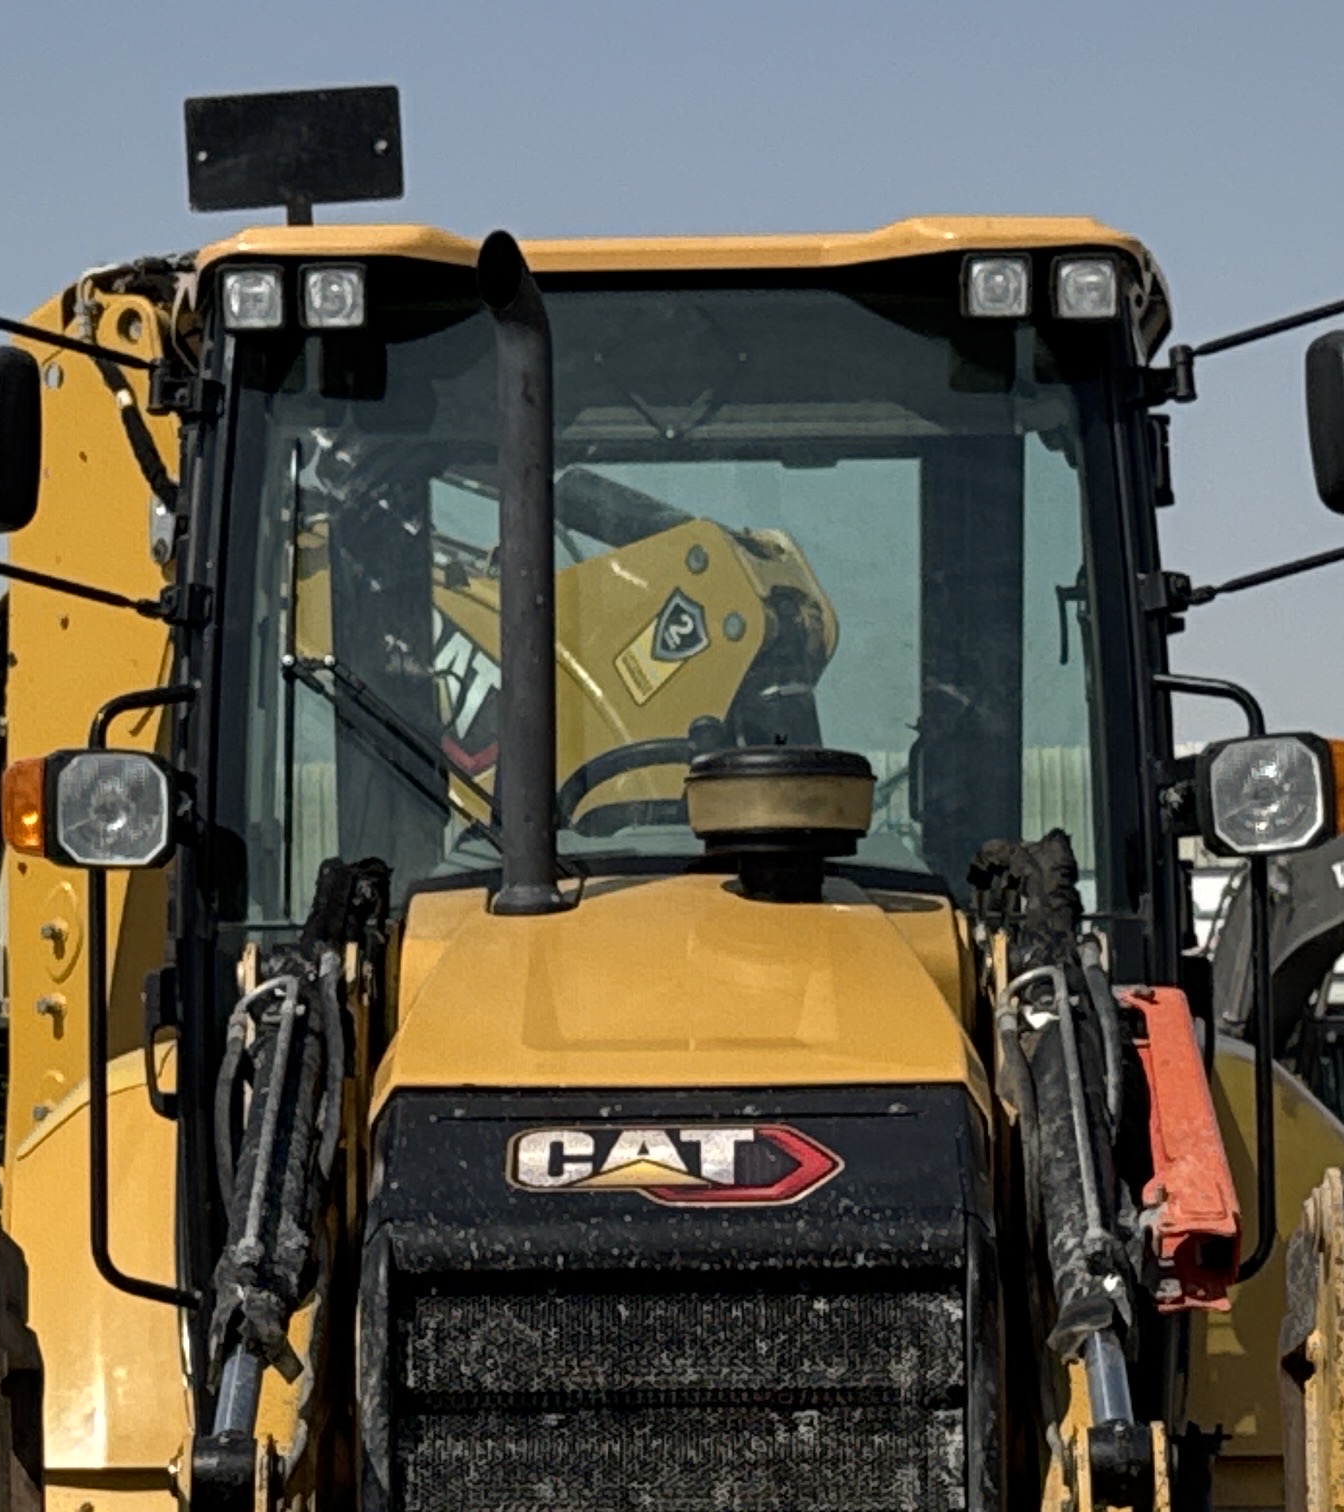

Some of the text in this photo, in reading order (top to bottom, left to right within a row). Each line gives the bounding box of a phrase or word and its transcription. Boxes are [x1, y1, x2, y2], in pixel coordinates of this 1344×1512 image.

[669, 613, 694, 646] 2
[432, 608, 502, 740] AT
[517, 1128, 754, 1187] CAT
